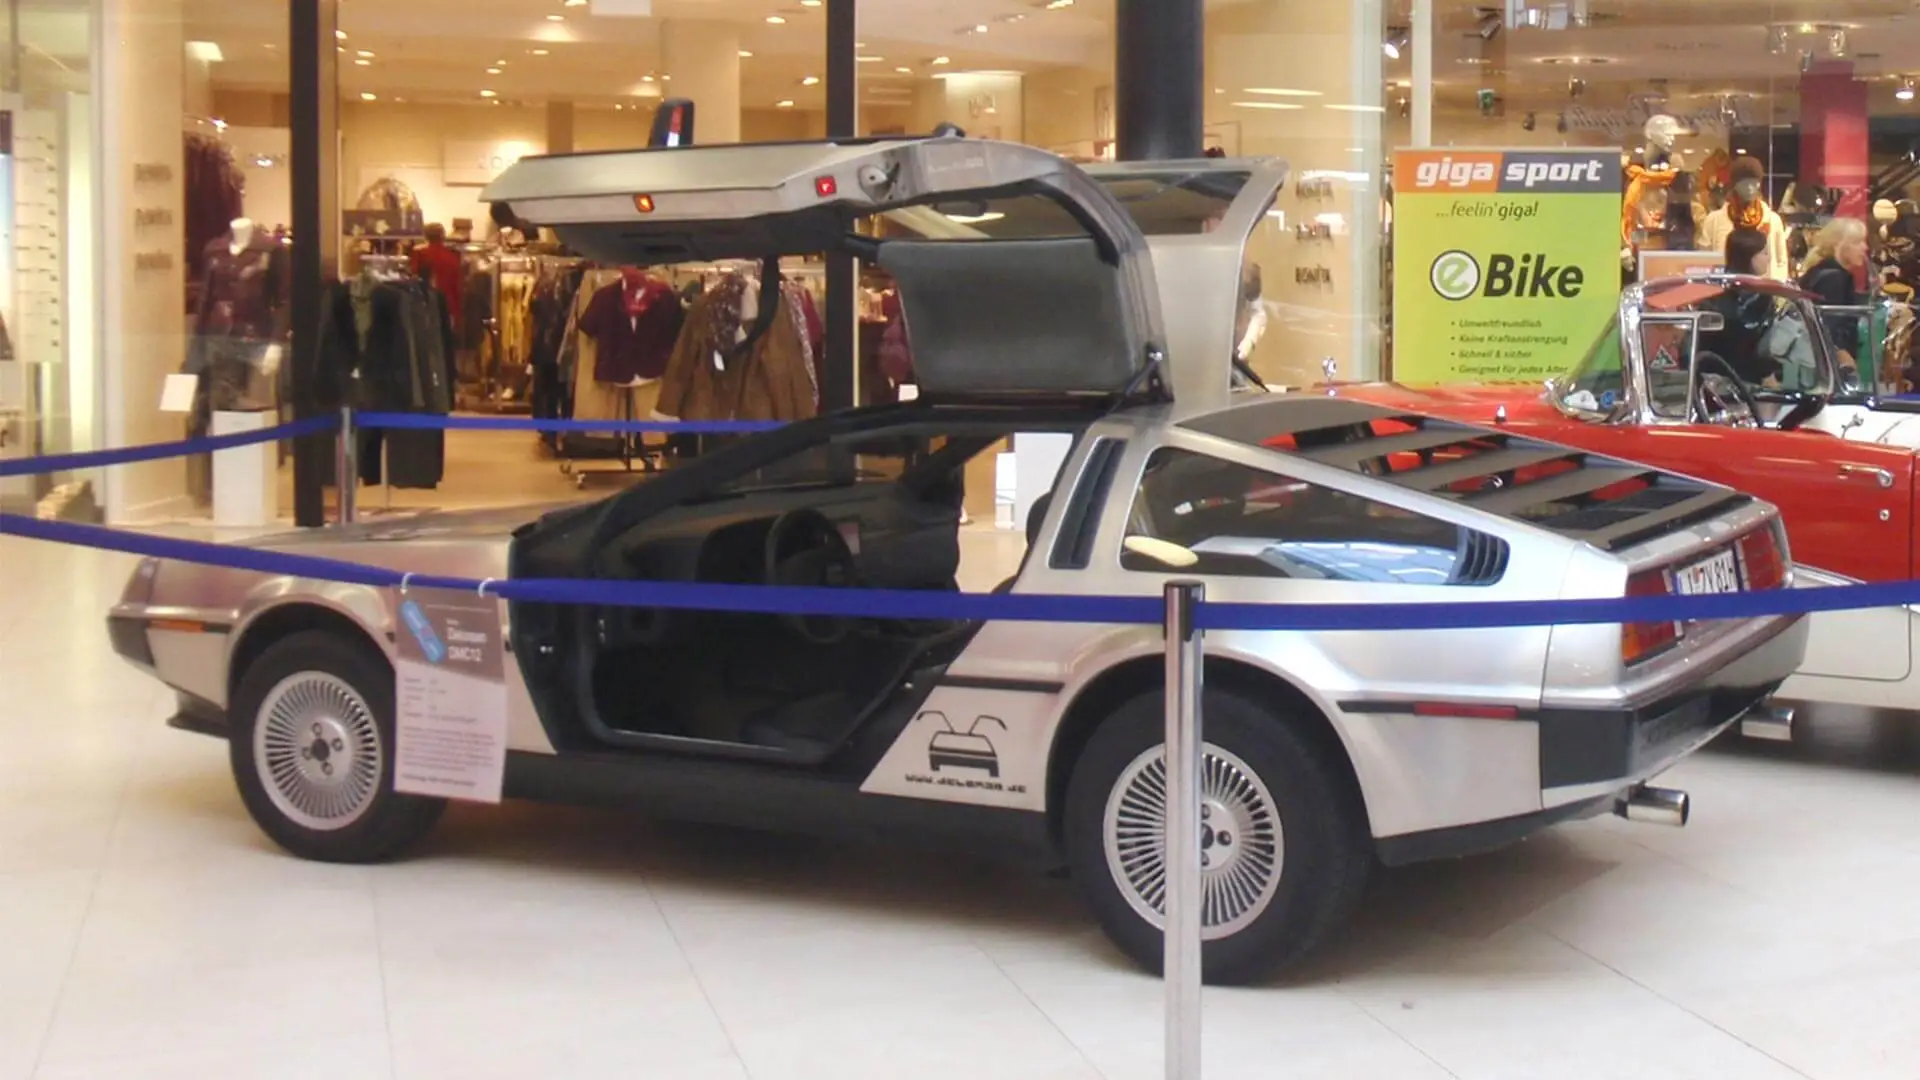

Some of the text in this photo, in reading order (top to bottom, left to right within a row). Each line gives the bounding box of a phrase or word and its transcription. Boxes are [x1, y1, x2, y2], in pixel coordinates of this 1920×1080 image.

[1415, 157, 1603, 187] giga sport
[1459, 319, 1542, 328] Umweltfreundlich
[1459, 334, 1485, 343] Keine
[1459, 350, 1493, 358] Schnell
[1504, 350, 1532, 358] sicher
[1502, 365, 1517, 374] für
[1545, 365, 1568, 373] Alter
